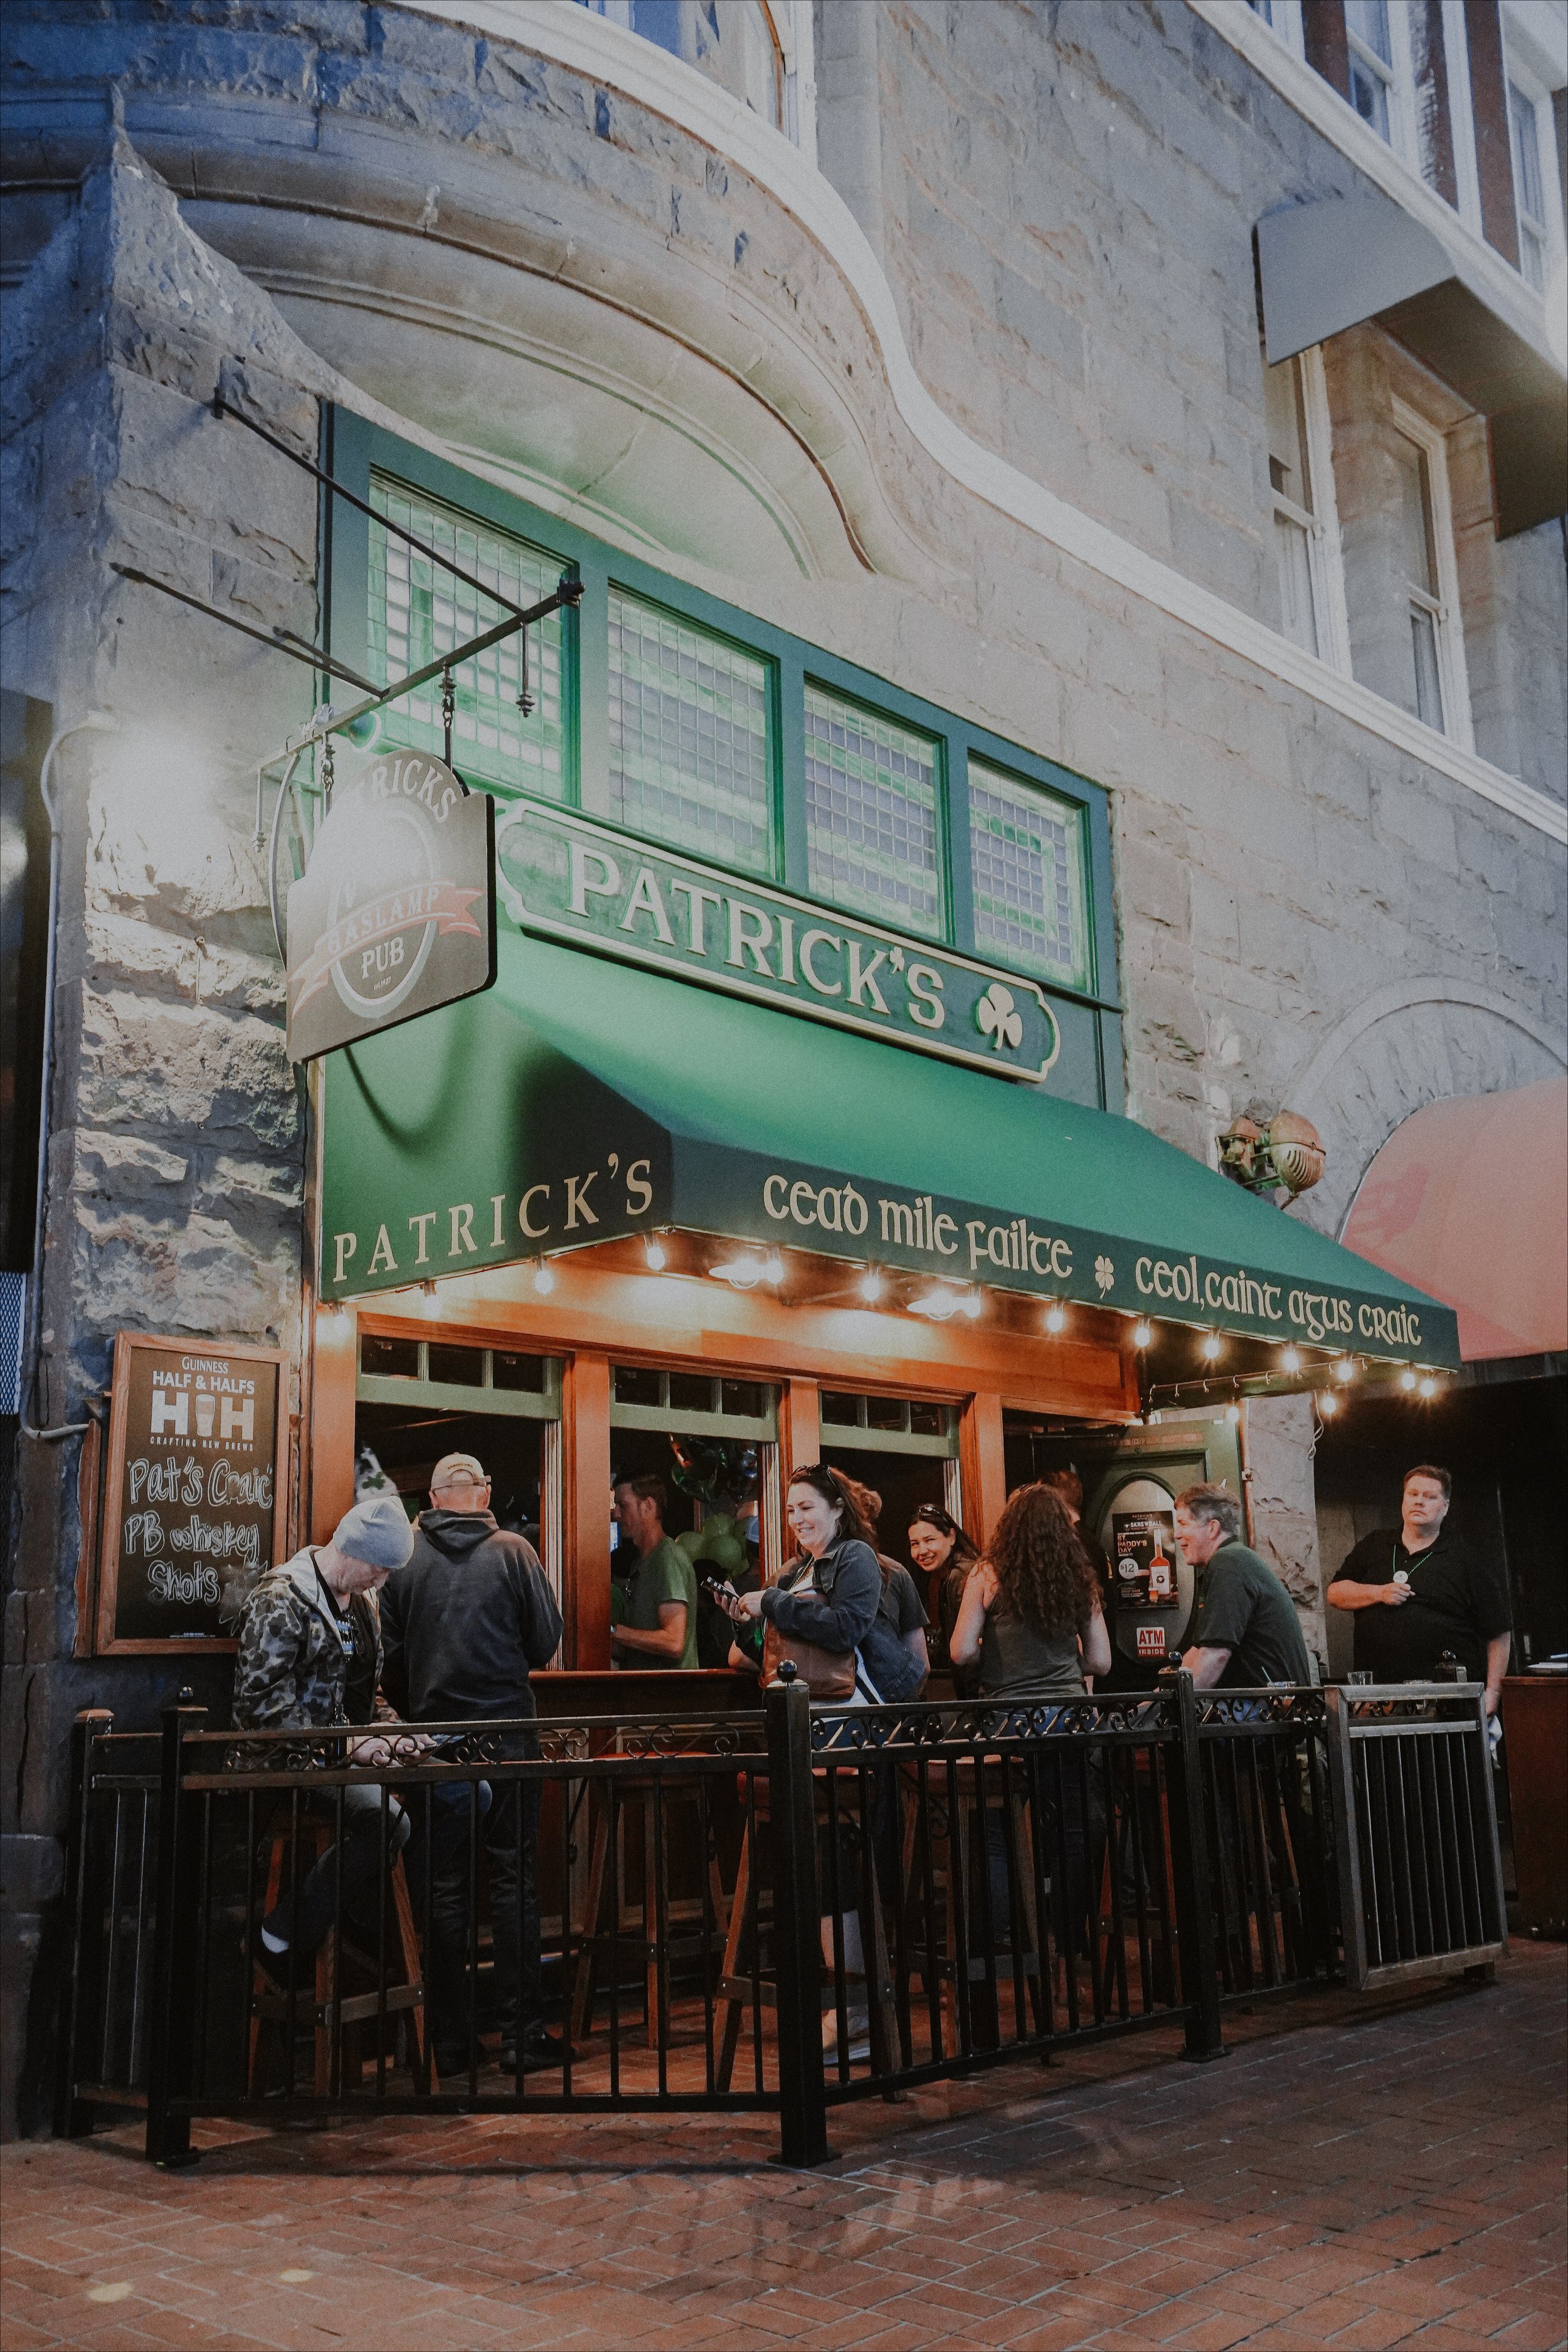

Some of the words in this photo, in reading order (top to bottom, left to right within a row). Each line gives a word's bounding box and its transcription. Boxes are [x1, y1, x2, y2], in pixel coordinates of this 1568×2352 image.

[361, 759, 457, 823] RICKS
[327, 887, 440, 955] GASLAMP
[566, 840, 946, 1030] PATRICK'S
[361, 936, 405, 979] PUB
[333, 1153, 653, 1283] PATRICK'S
[152, 1370, 192, 1388] HALF
[195, 1375, 207, 1391] &
[210, 1376, 255, 1395] HALFS
[181, 1356, 230, 1374] GUINNESS
[150, 1436, 197, 1448] CRAFTING
[202, 1439, 220, 1449] NEW
[225, 1441, 254, 1452] BREWS
[125, 1510, 166, 1557] PB
[170, 1514, 260, 1568] whiskey
[1117, 1540, 1147, 1548] PADDY'S
[148, 1560, 221, 1604] Shots
[1139, 1630, 1163, 1645] ATM
